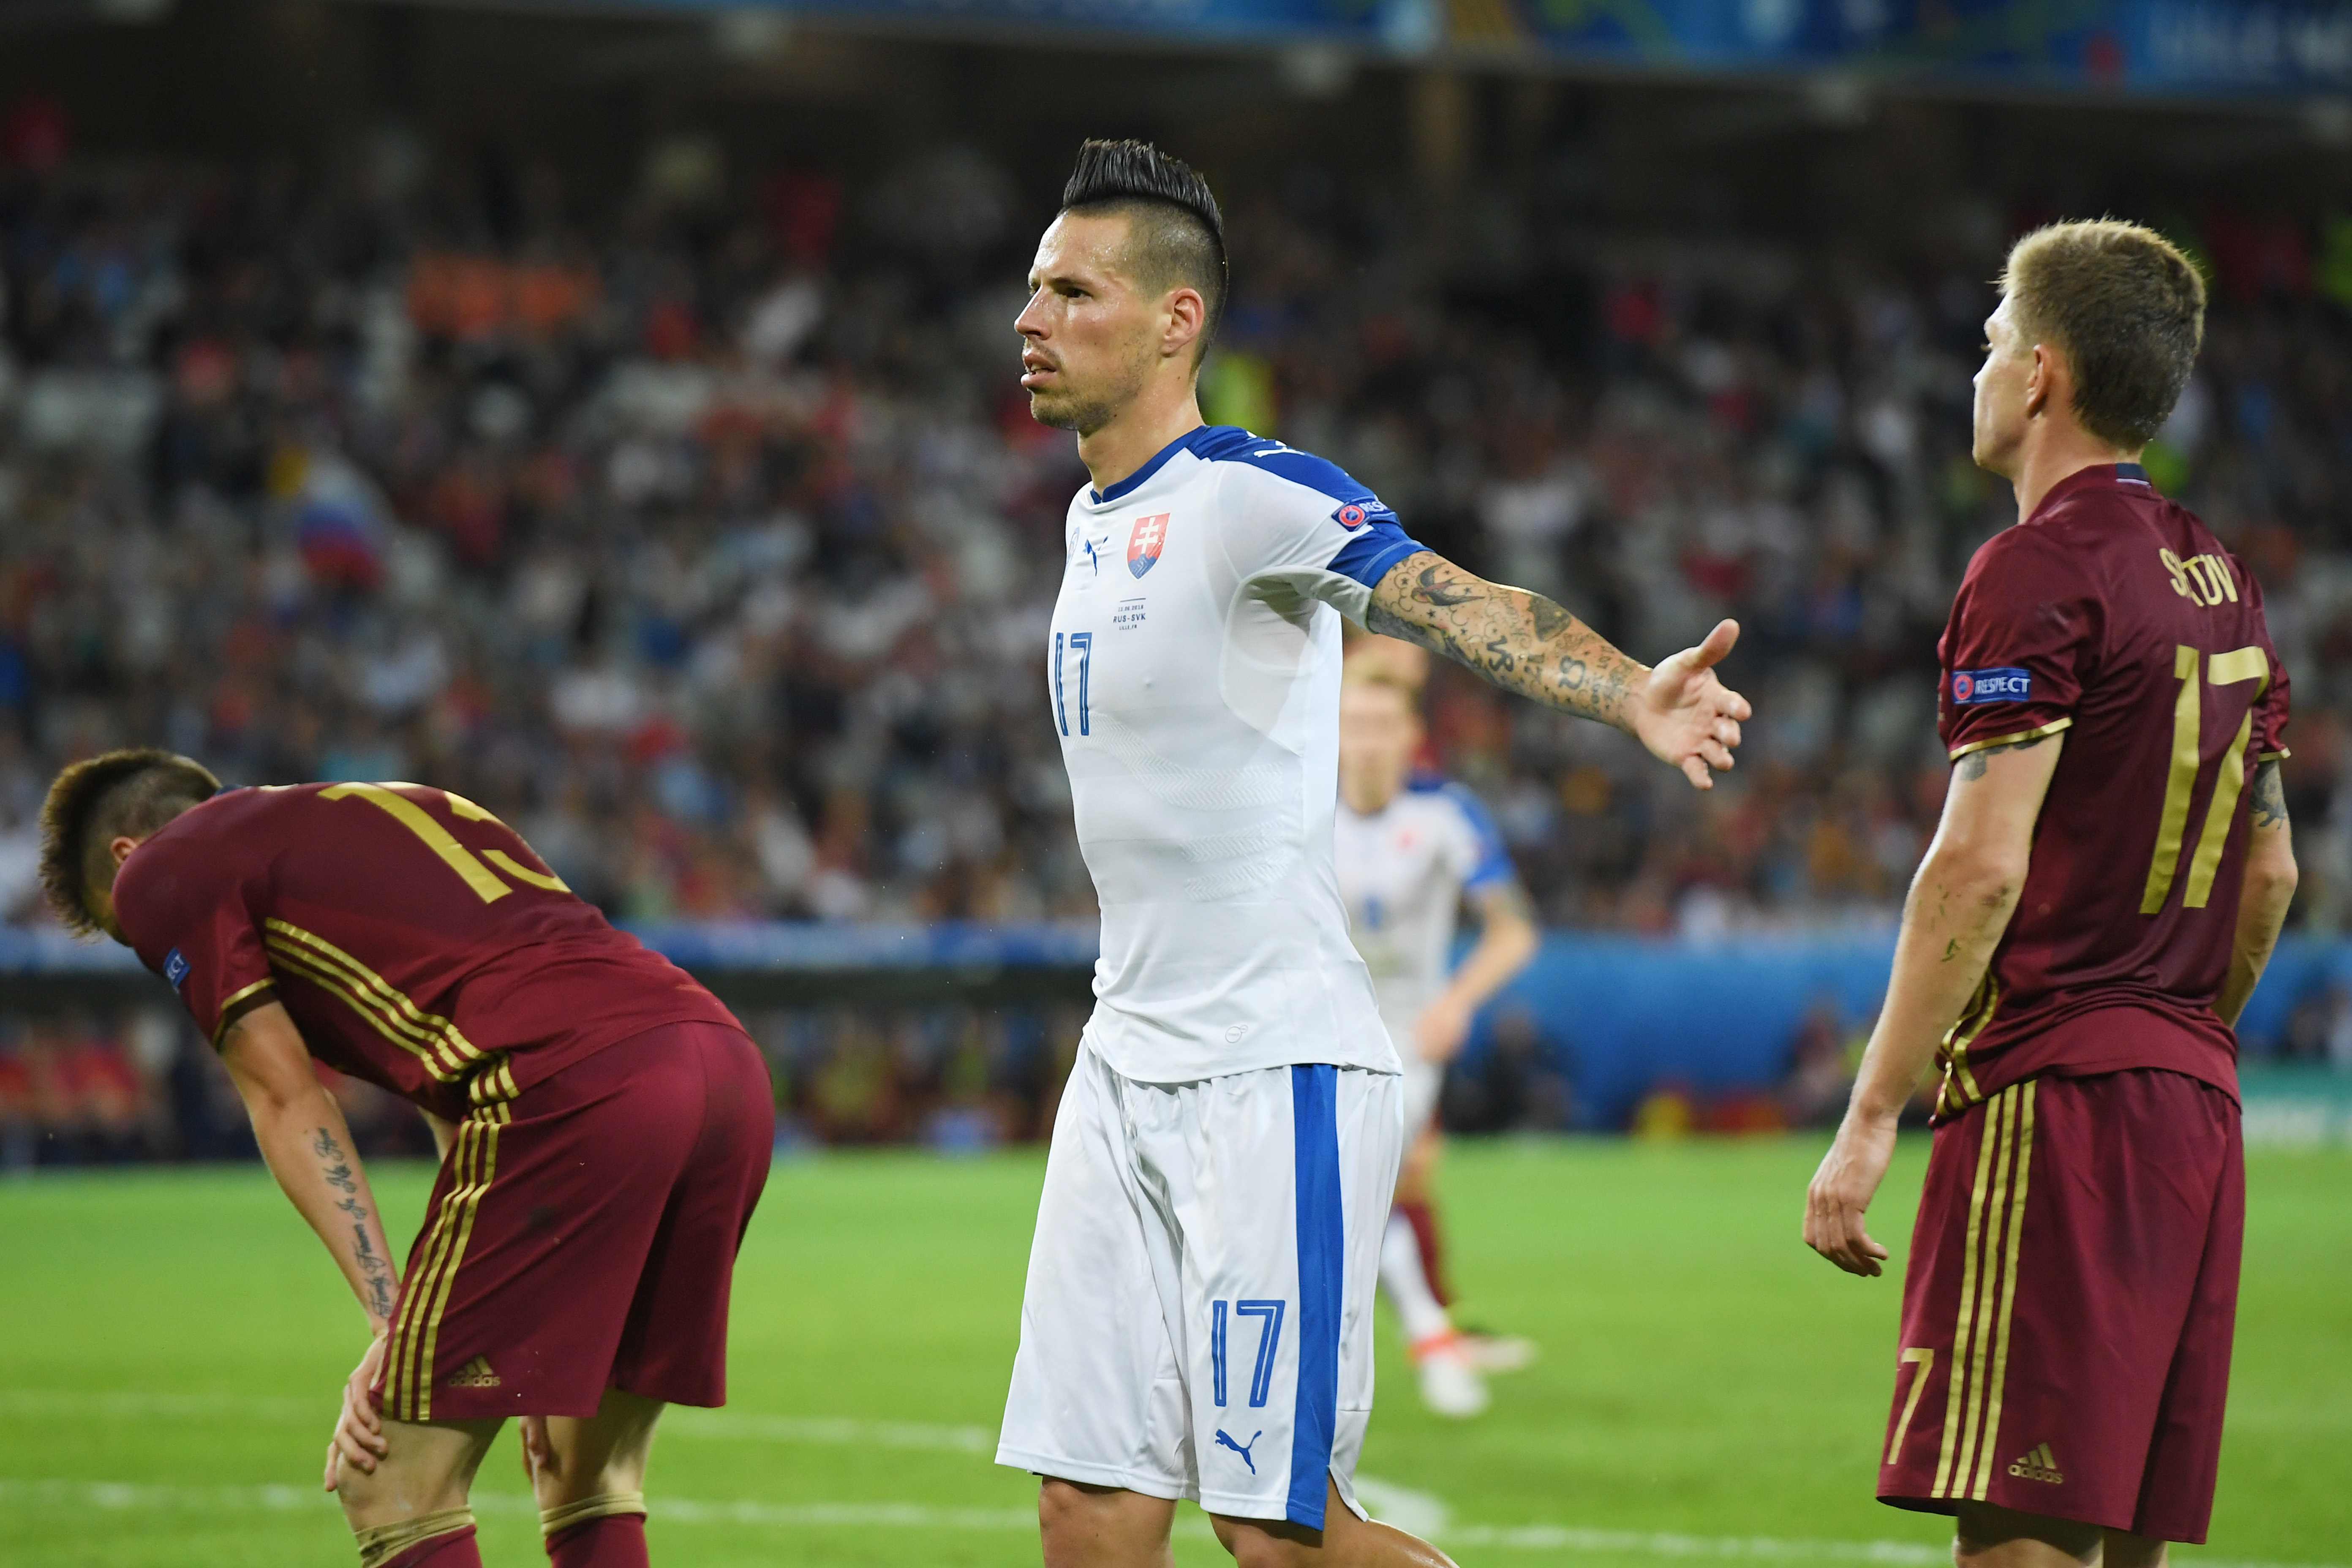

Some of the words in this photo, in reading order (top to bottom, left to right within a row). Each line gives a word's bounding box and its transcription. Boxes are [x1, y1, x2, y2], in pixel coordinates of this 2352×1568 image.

[1113, 612, 1146, 623] RUS-SVK
[1055, 632, 1092, 736] 17
[2139, 645, 2270, 914] 17
[1211, 1300, 1286, 1407] 17
